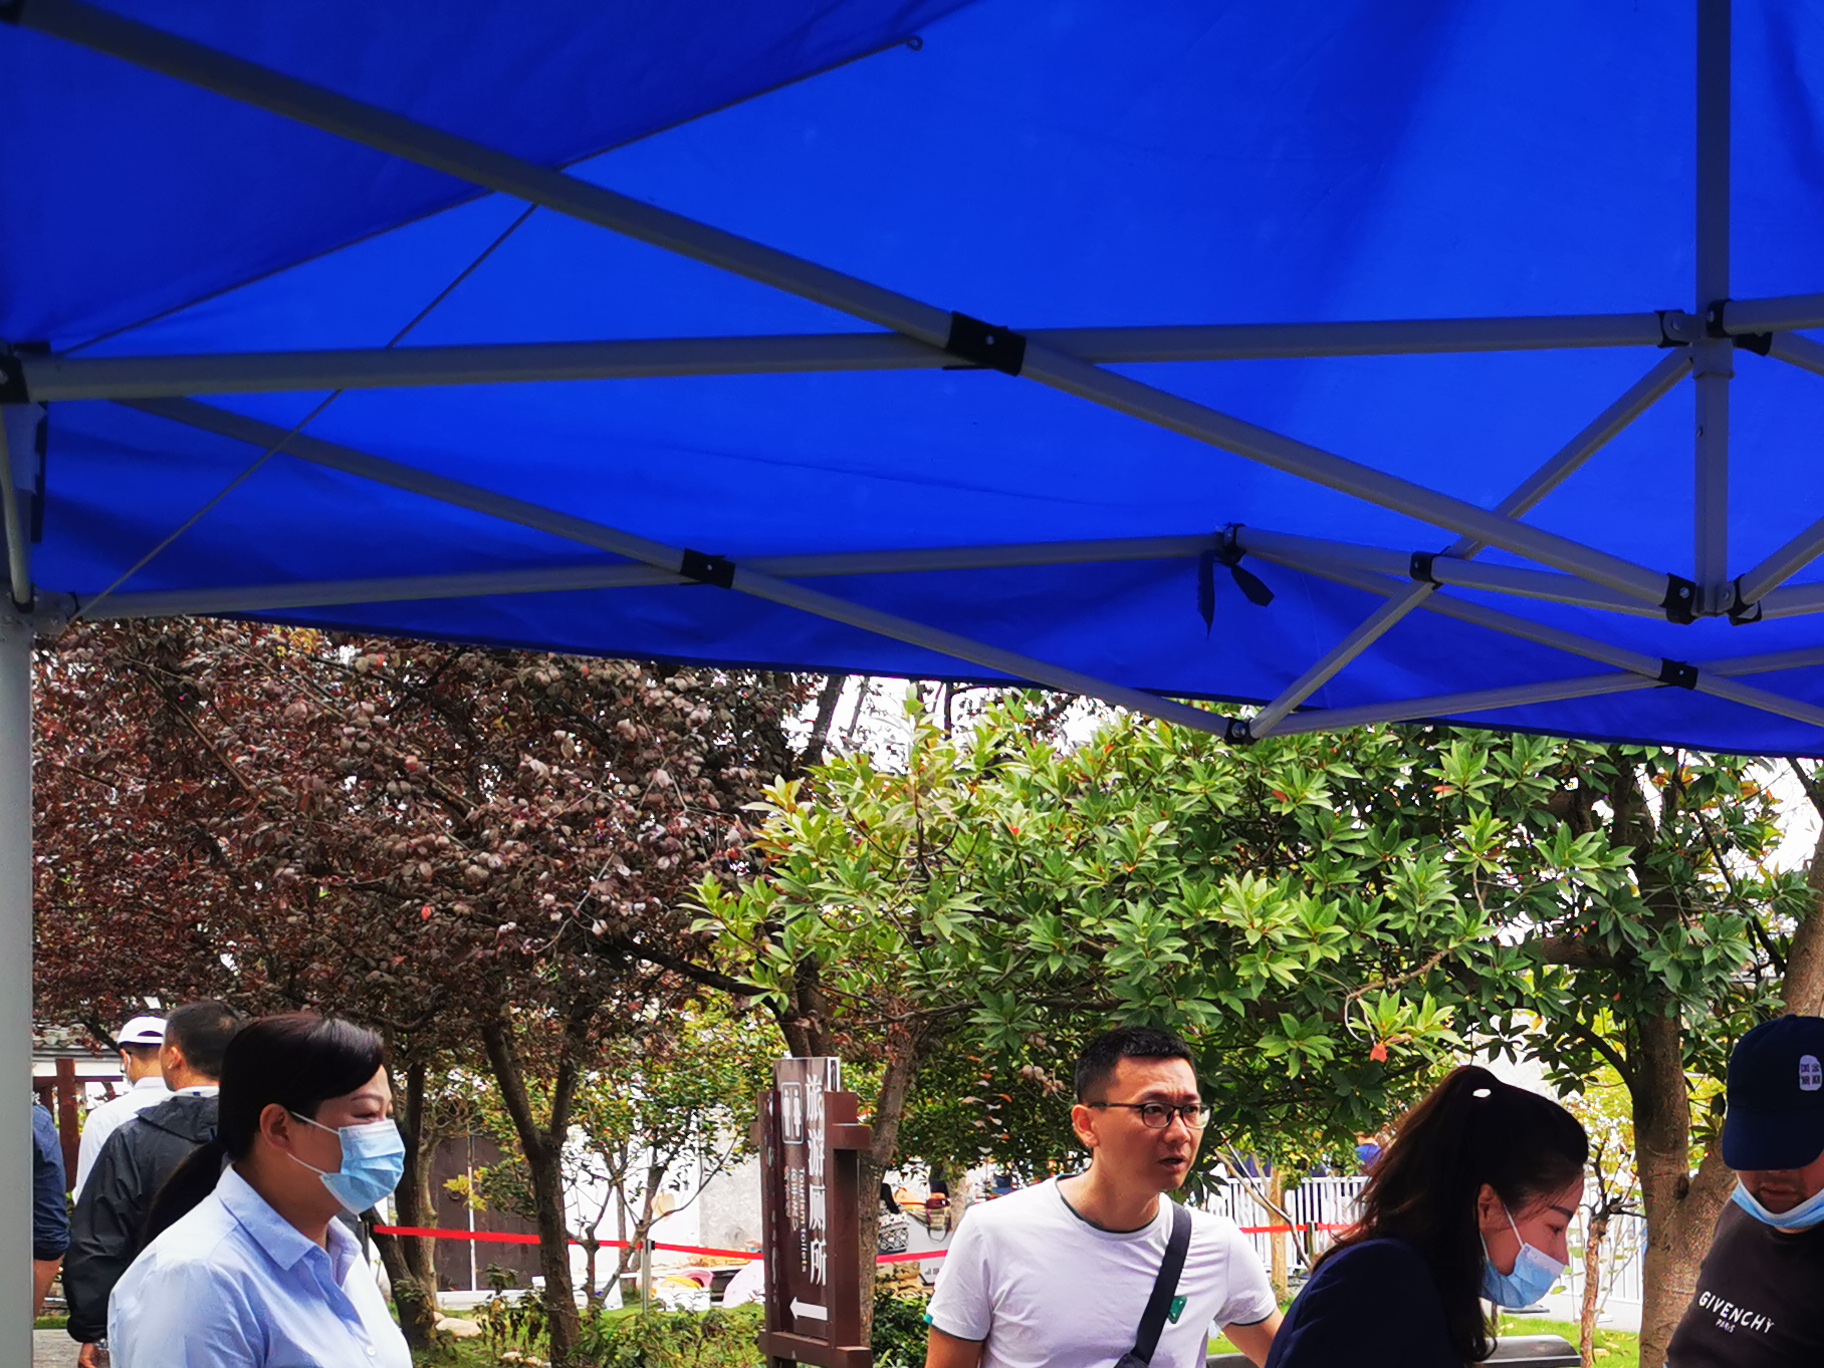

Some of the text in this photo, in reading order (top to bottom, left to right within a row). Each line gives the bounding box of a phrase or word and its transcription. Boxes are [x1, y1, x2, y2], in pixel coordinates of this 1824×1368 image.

[806, 1073, 828, 1287] 旅游厕所
[1698, 1291, 1775, 1334] GIVENCHY
[1714, 1318, 1736, 1333] PARIS
